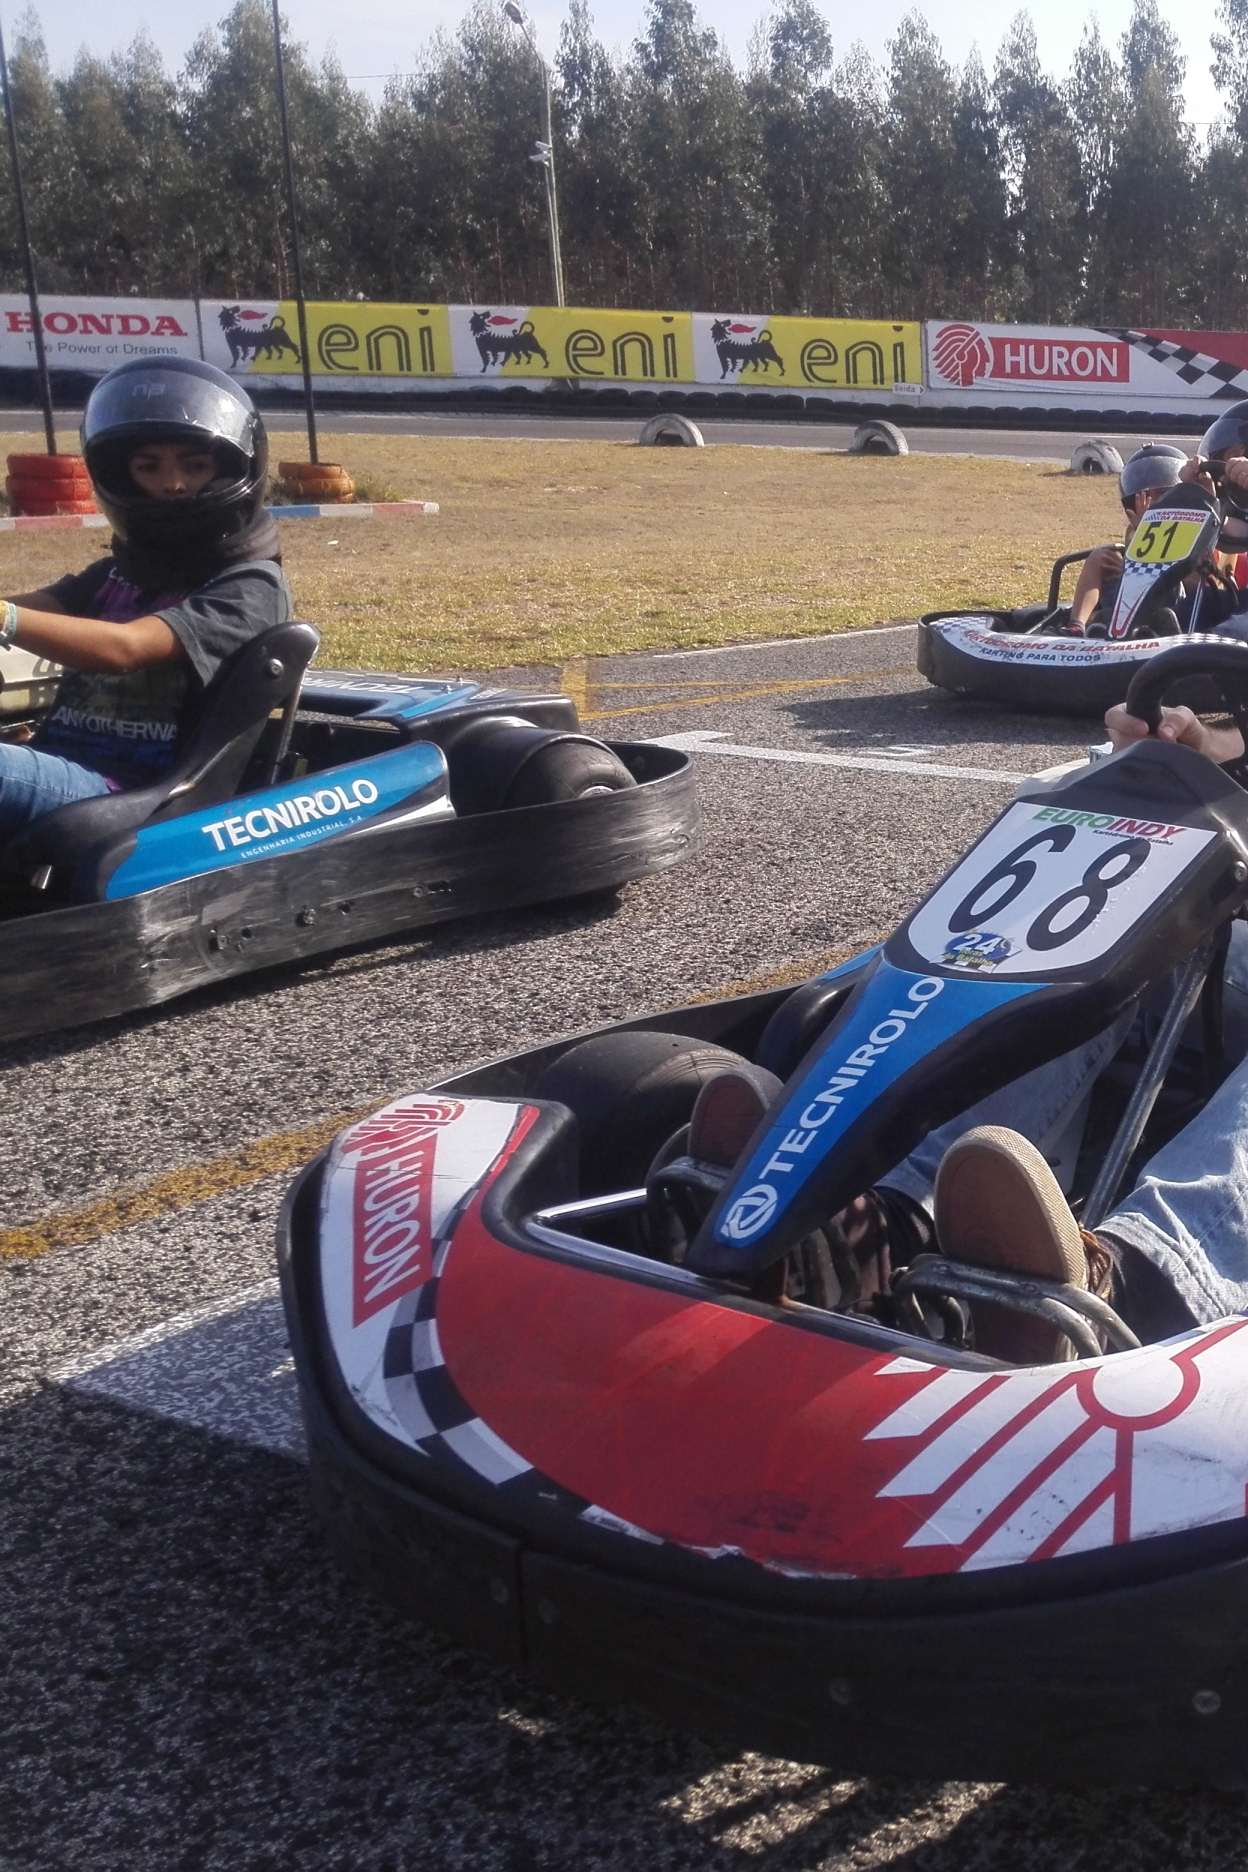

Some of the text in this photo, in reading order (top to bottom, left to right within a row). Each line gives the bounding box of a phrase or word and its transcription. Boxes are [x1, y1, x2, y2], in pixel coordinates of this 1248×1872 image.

[5, 311, 188, 336] HONDA
[26, 340, 178, 355] Te Power of Dreams
[317, 308, 437, 373] eni
[565, 316, 678, 378] eni
[800, 325, 906, 385] eni
[1004, 343, 1118, 377] HURON
[1135, 521, 1180, 559] 51
[979, 646, 1101, 662] KARTING PARA TODOS
[202, 778, 379, 852] TECNIROLO
[1031, 807, 1186, 838] EUROINDY
[240, 836, 296, 860] ENGENHARIA
[947, 823, 1152, 951] 68
[759, 976, 945, 1181] TECNIROLO
[363, 1150, 425, 1304] HURON
